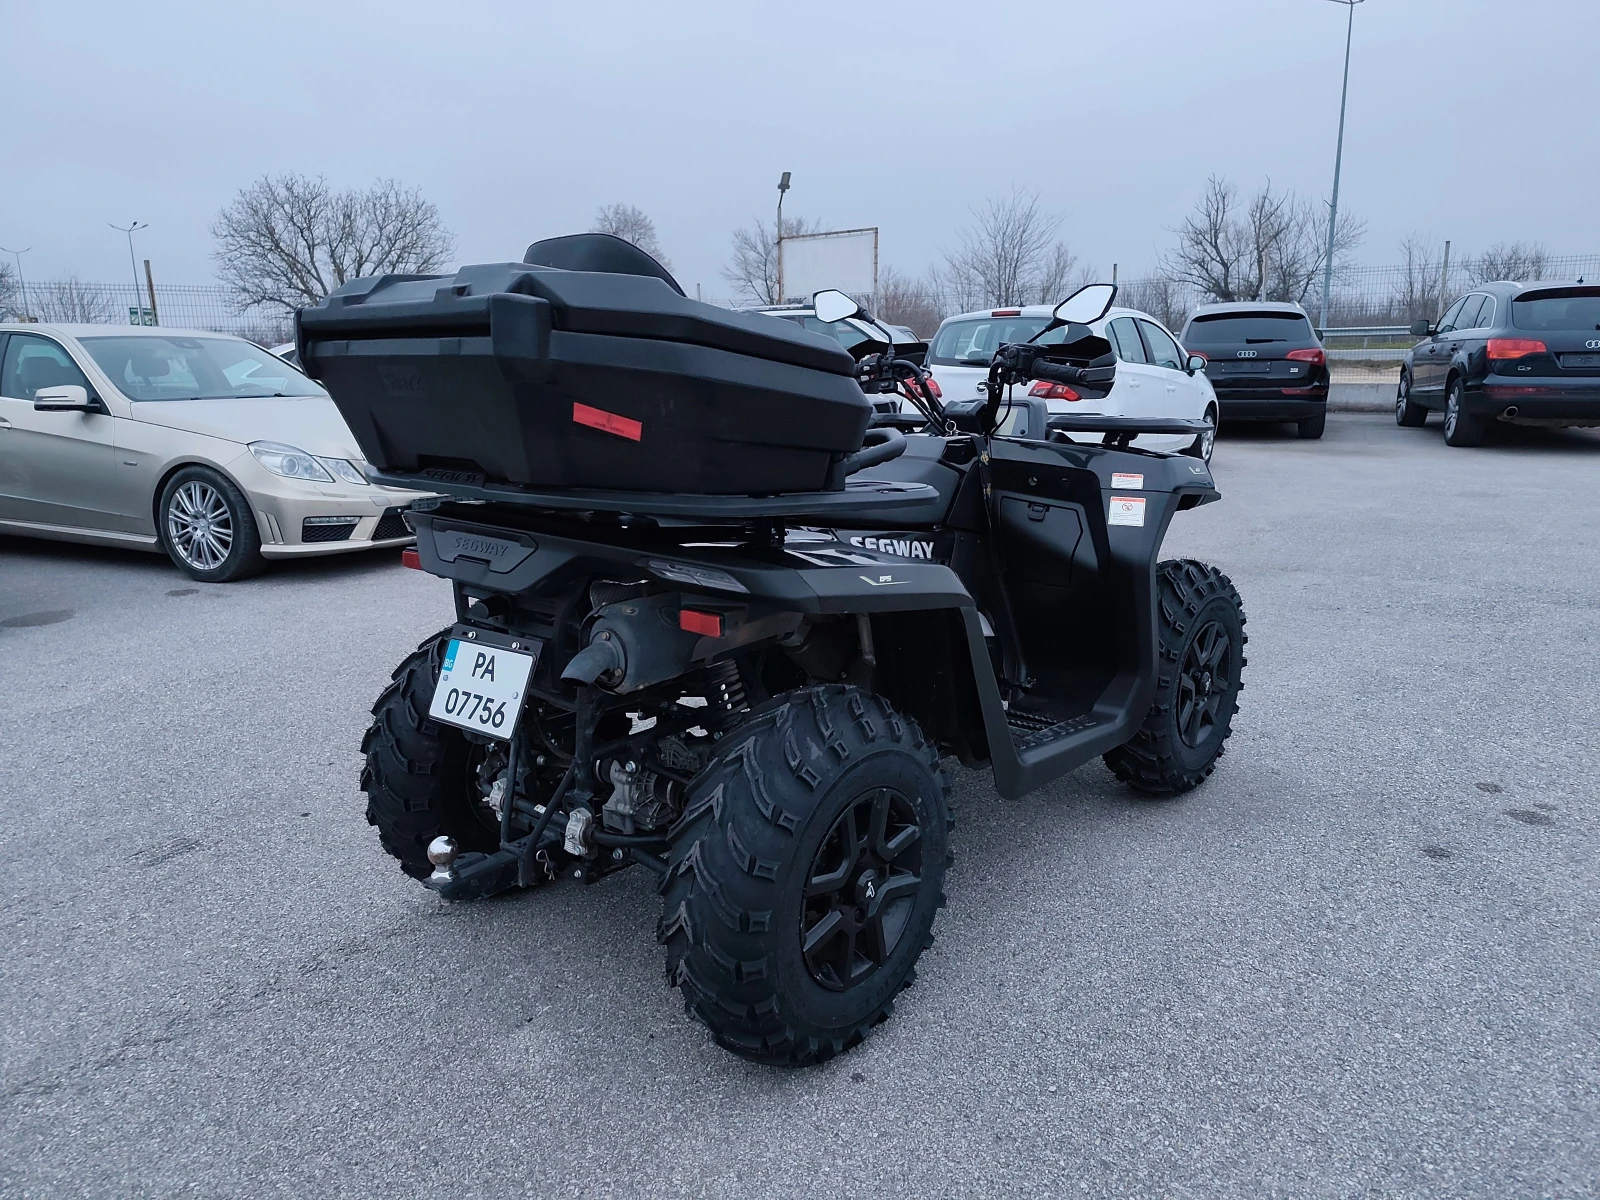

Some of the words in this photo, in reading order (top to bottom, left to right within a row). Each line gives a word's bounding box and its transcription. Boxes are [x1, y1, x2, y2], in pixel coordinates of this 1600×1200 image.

[425, 468, 481, 484] SEGWAY
[452, 536, 509, 557] SEGWAY
[444, 658, 454, 668] BG
[471, 651, 495, 682] PA
[445, 687, 507, 728] 07756
